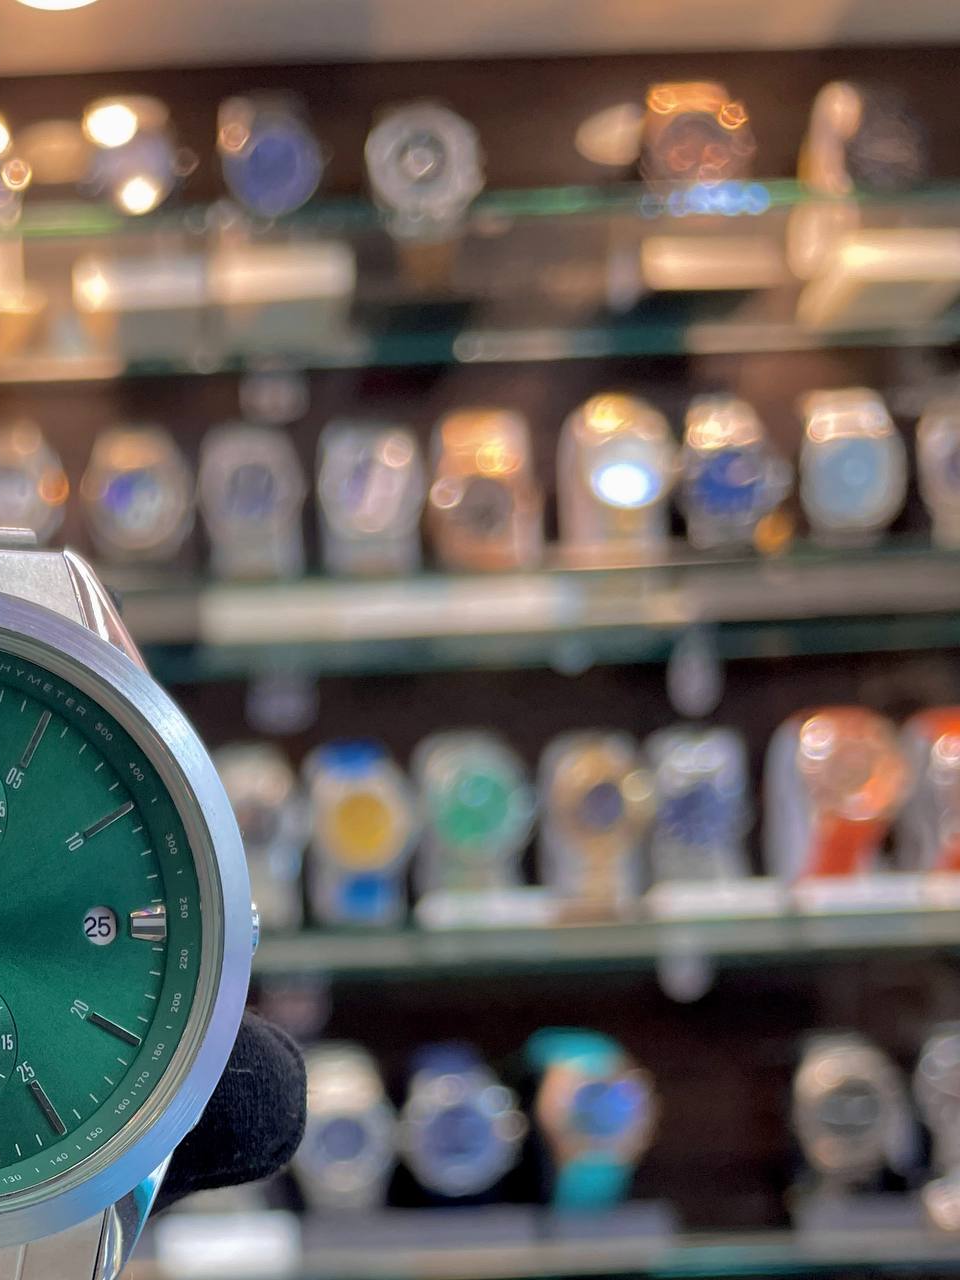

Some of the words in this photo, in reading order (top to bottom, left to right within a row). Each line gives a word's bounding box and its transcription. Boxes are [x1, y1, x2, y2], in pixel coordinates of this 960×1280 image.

[5, 767, 25, 789] 05
[129, 762, 145, 781] 400
[65, 832, 84, 852] 10
[165, 832, 178, 855] 300
[179, 897, 189, 919] 250
[83, 916, 111, 938] 25
[179, 949, 189, 969] 220
[70, 999, 89, 1020] 20
[171, 992, 182, 1013] 200
[0, 1034, 14, 1051] 15
[152, 1043, 165, 1062] 180
[16, 1060, 36, 1083] 25
[135, 1071, 150, 1089] 170
[114, 1098, 130, 1115] 160
[86, 1127, 103, 1142] 150
[49, 1152, 69, 1166] 140
[1, 1174, 22, 1185] 130
